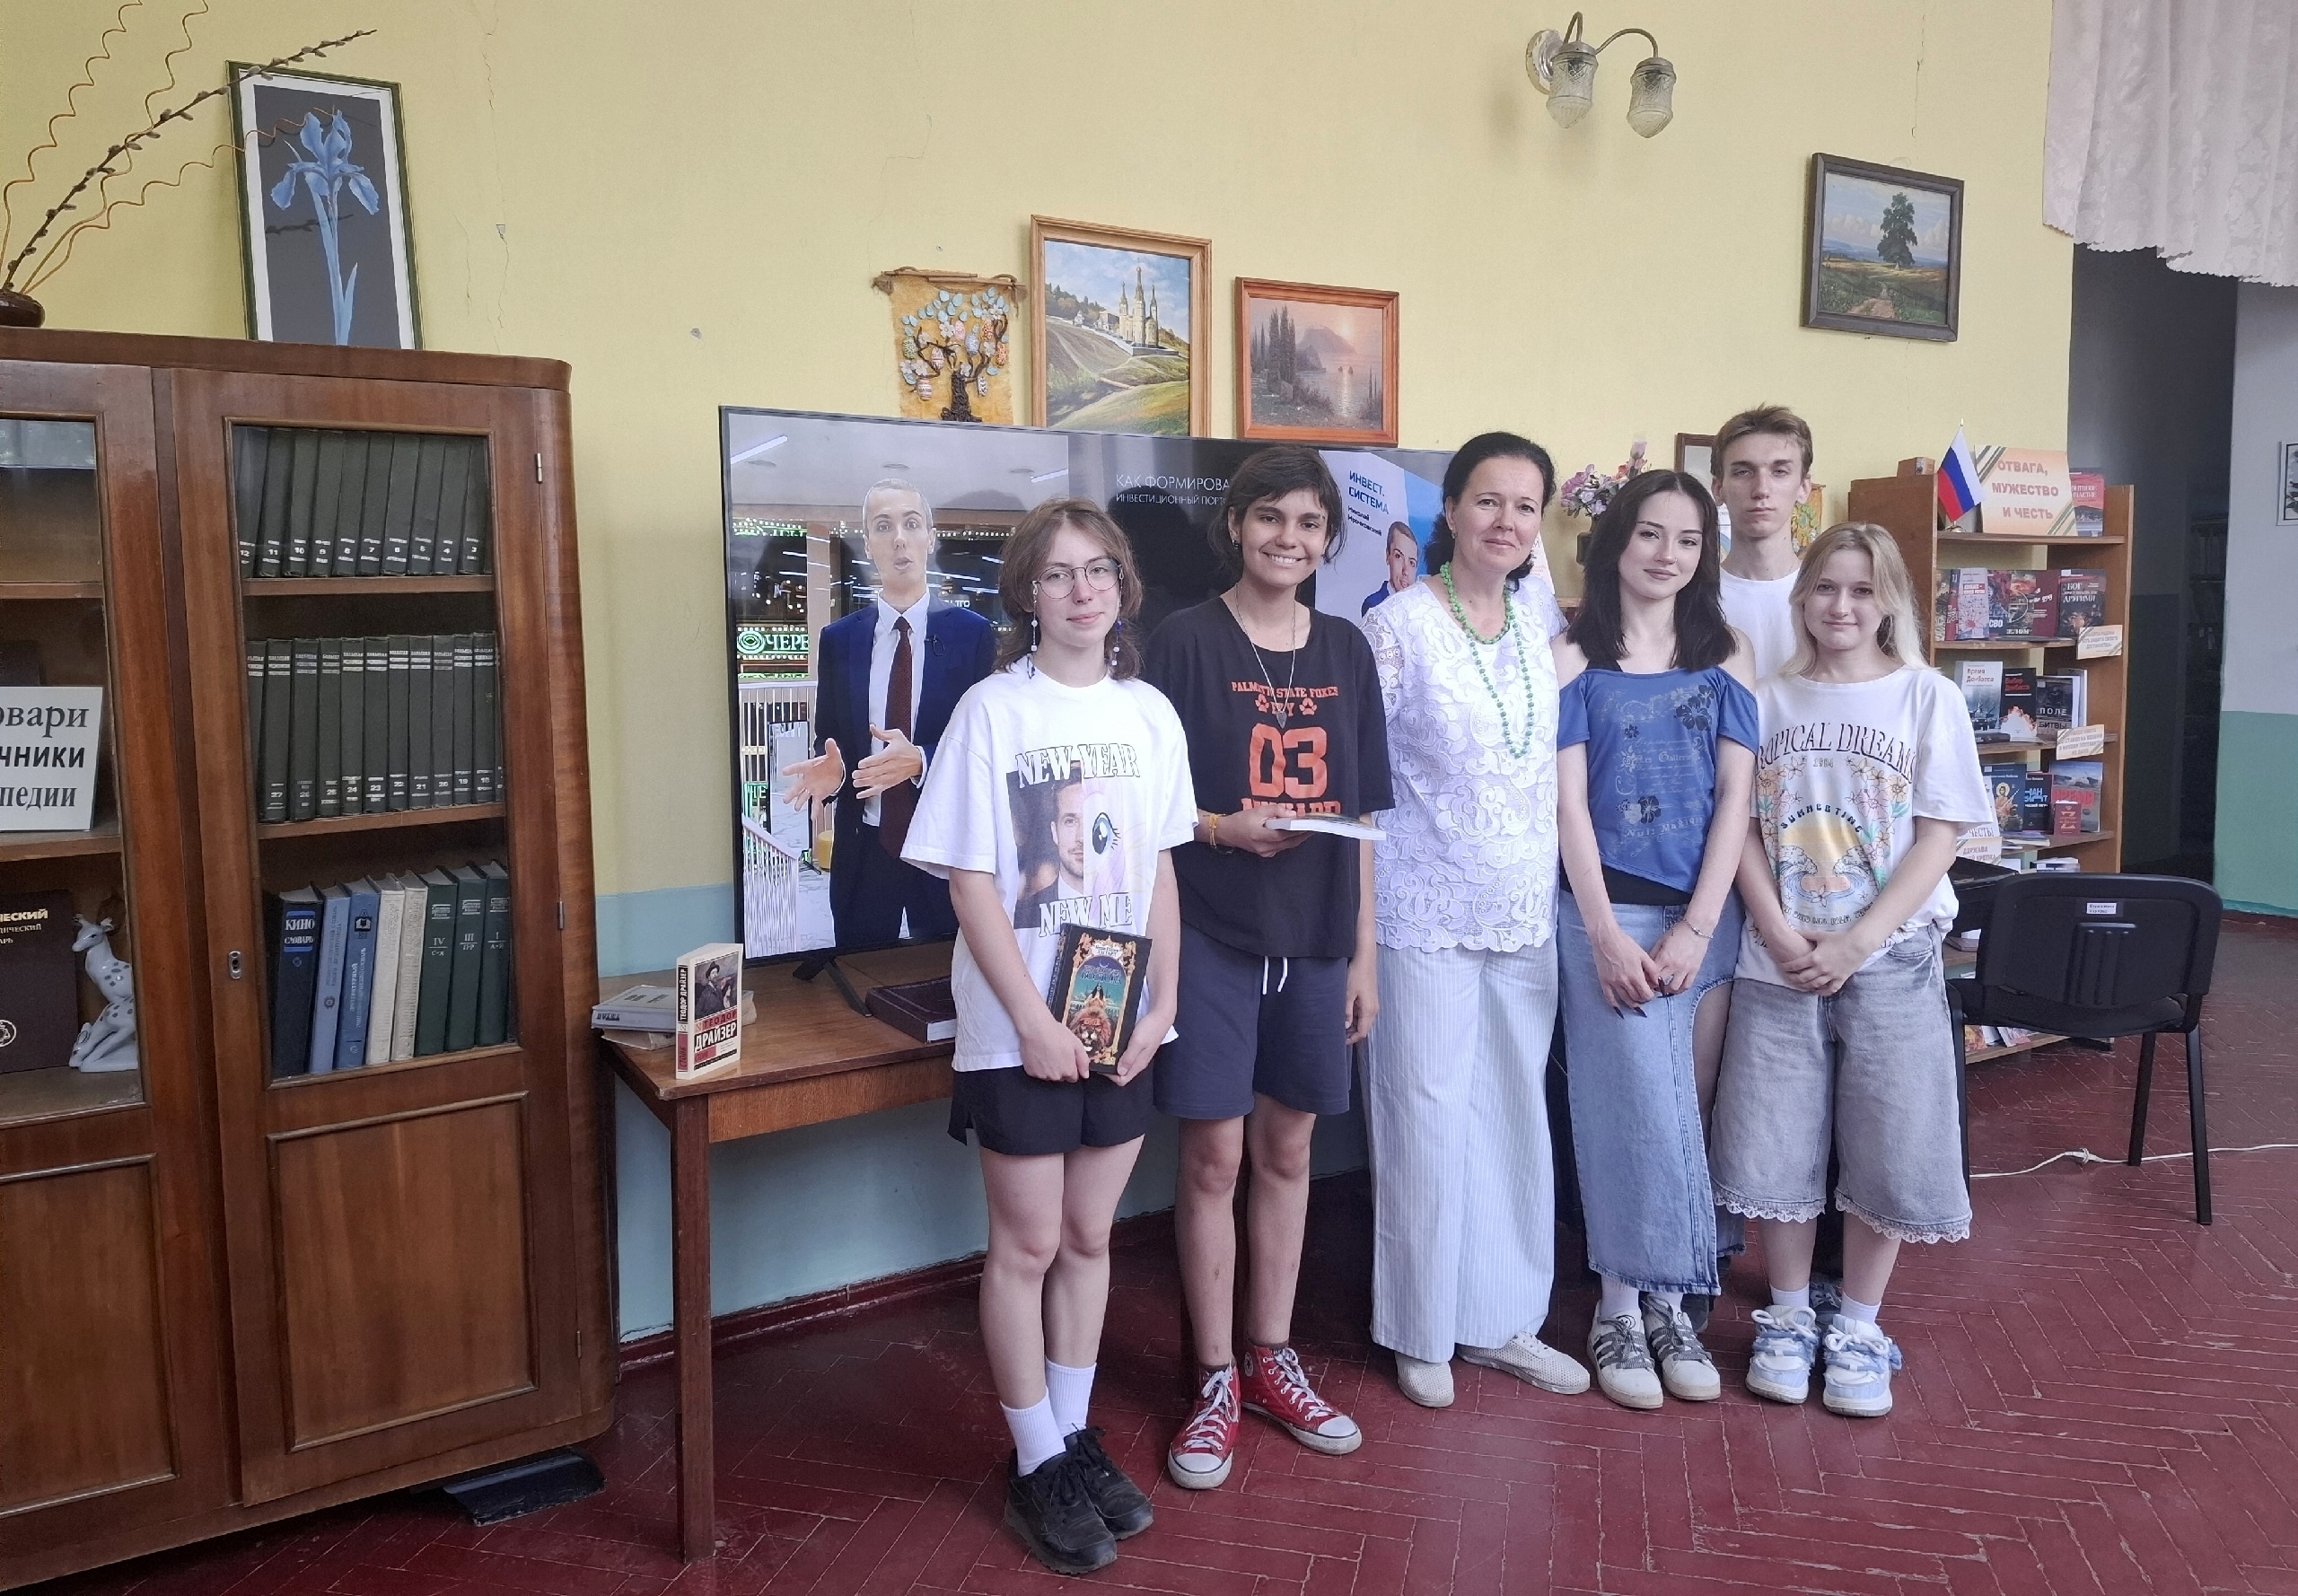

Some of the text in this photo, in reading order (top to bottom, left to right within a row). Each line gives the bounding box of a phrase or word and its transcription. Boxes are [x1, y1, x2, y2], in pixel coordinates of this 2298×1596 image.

[1997, 460, 2048, 476] ОТВАГА,
[1116, 474, 1232, 491] КАК ФОРМИРОВА
[1349, 470, 1385, 497] ИНВЕСТ.
[1991, 482, 2059, 496] МУЖЕСТВО
[1116, 493, 1200, 505] ИНВЕСТИЦИОННЫЙ
[1348, 487, 1389, 514] СИСТЕМА
[2002, 506, 2054, 520] И ЧЕСТЬ
[1967, 668, 1986, 676] Время
[1276, 687, 1308, 697] STATE
[1310, 686, 1339, 698] FOXES
[2039, 707, 2067, 715] ПОЛЕ
[0, 706, 89, 738] вари
[1757, 723, 1832, 774] ROPICAL
[1015, 742, 1141, 789] NEW YEAR
[1250, 723, 1328, 799] 03
[1780, 803, 1864, 833] SUMMERTIME
[1039, 892, 1133, 938] NEW ME
[285, 918, 315, 931] КИНО
[284, 935, 314, 944] СЛОВАРЬ
[434, 937, 446, 946] IV
[464, 933, 475, 942] III
[680, 969, 688, 1021] ТЕОДОР ДРАЙЗЕР
[703, 1010, 737, 1028] ТЕОДОР
[695, 1022, 737, 1053] ДРАЙЗЕР
